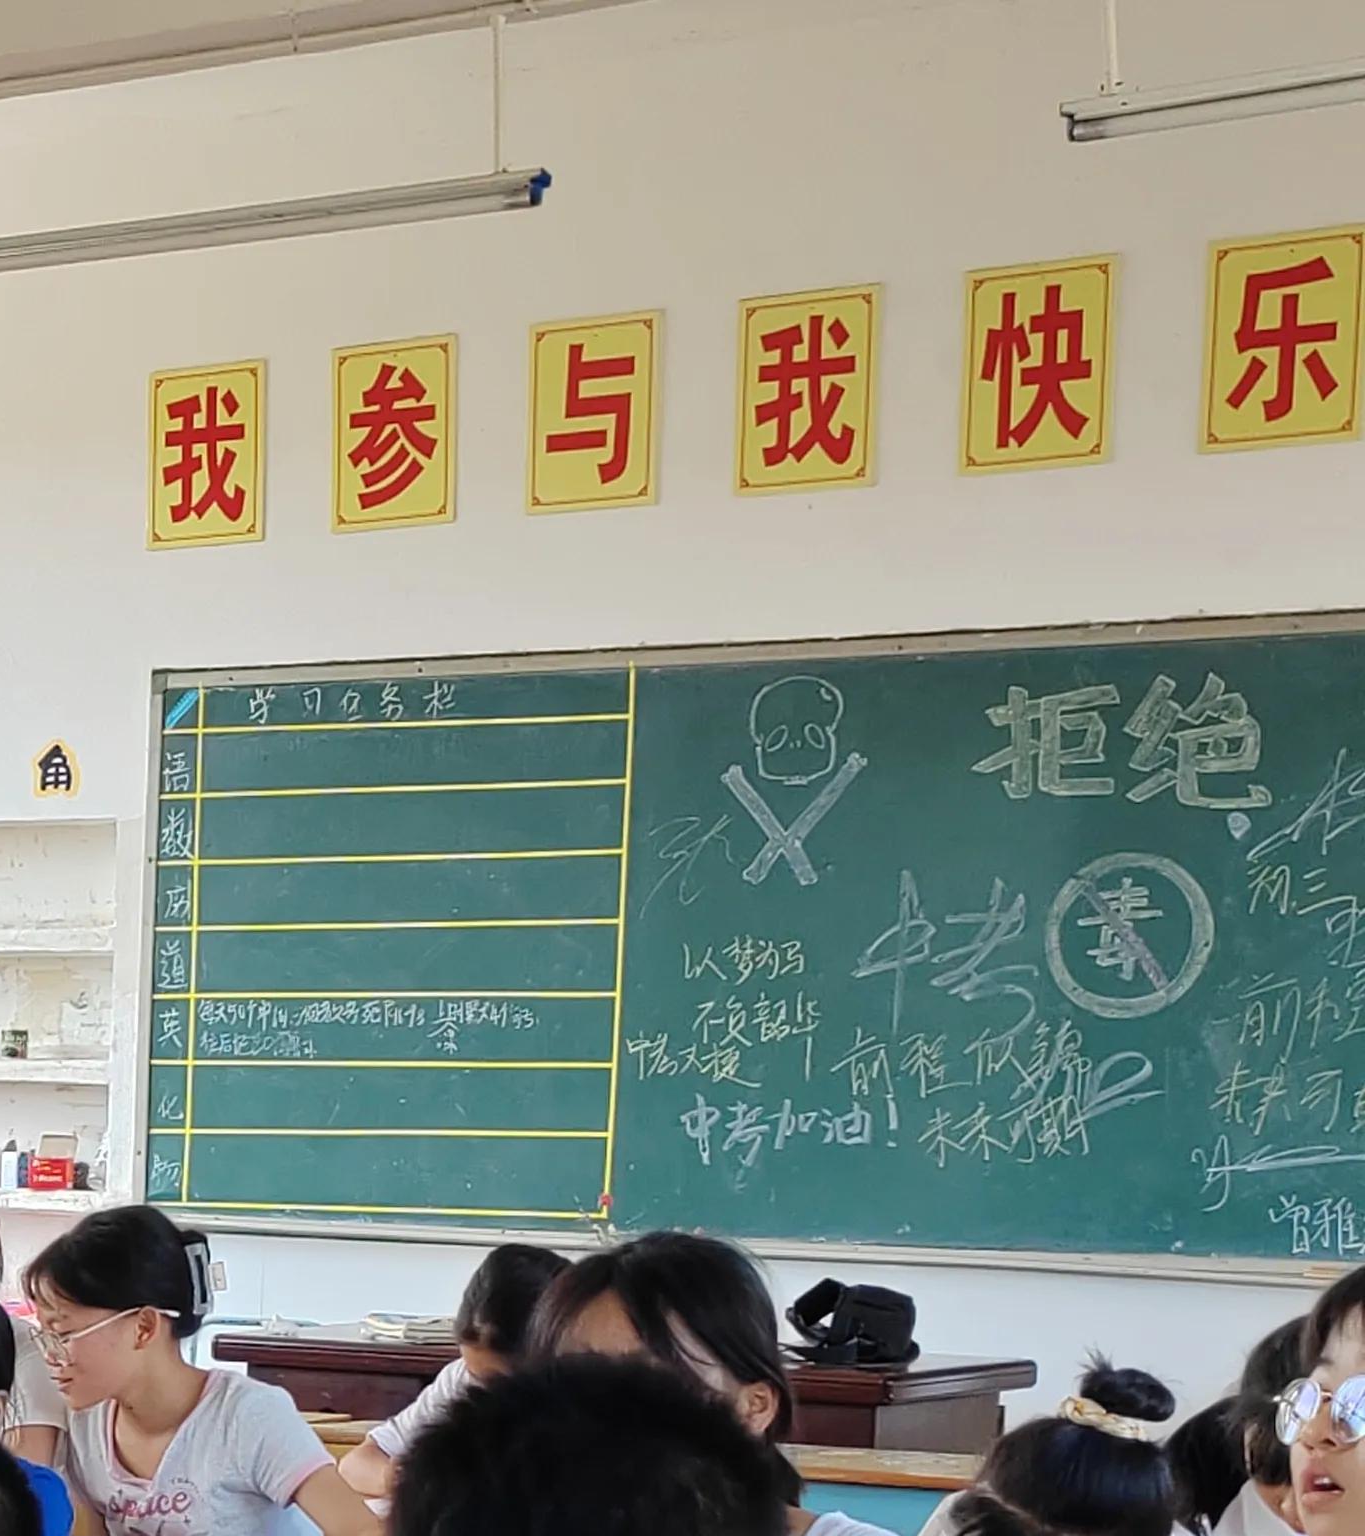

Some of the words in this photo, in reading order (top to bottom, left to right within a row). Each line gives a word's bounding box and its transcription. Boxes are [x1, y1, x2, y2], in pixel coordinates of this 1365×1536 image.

[162, 259, 1339, 525] 我参与我快乐
[970, 672, 1273, 809] 拒绝
[162, 751, 191, 792] 语
[161, 807, 194, 859] 数
[157, 939, 188, 989] 道
[682, 935, 805, 985] 以梦为马
[158, 1007, 183, 1048] 英
[158, 1095, 184, 1120] 化
